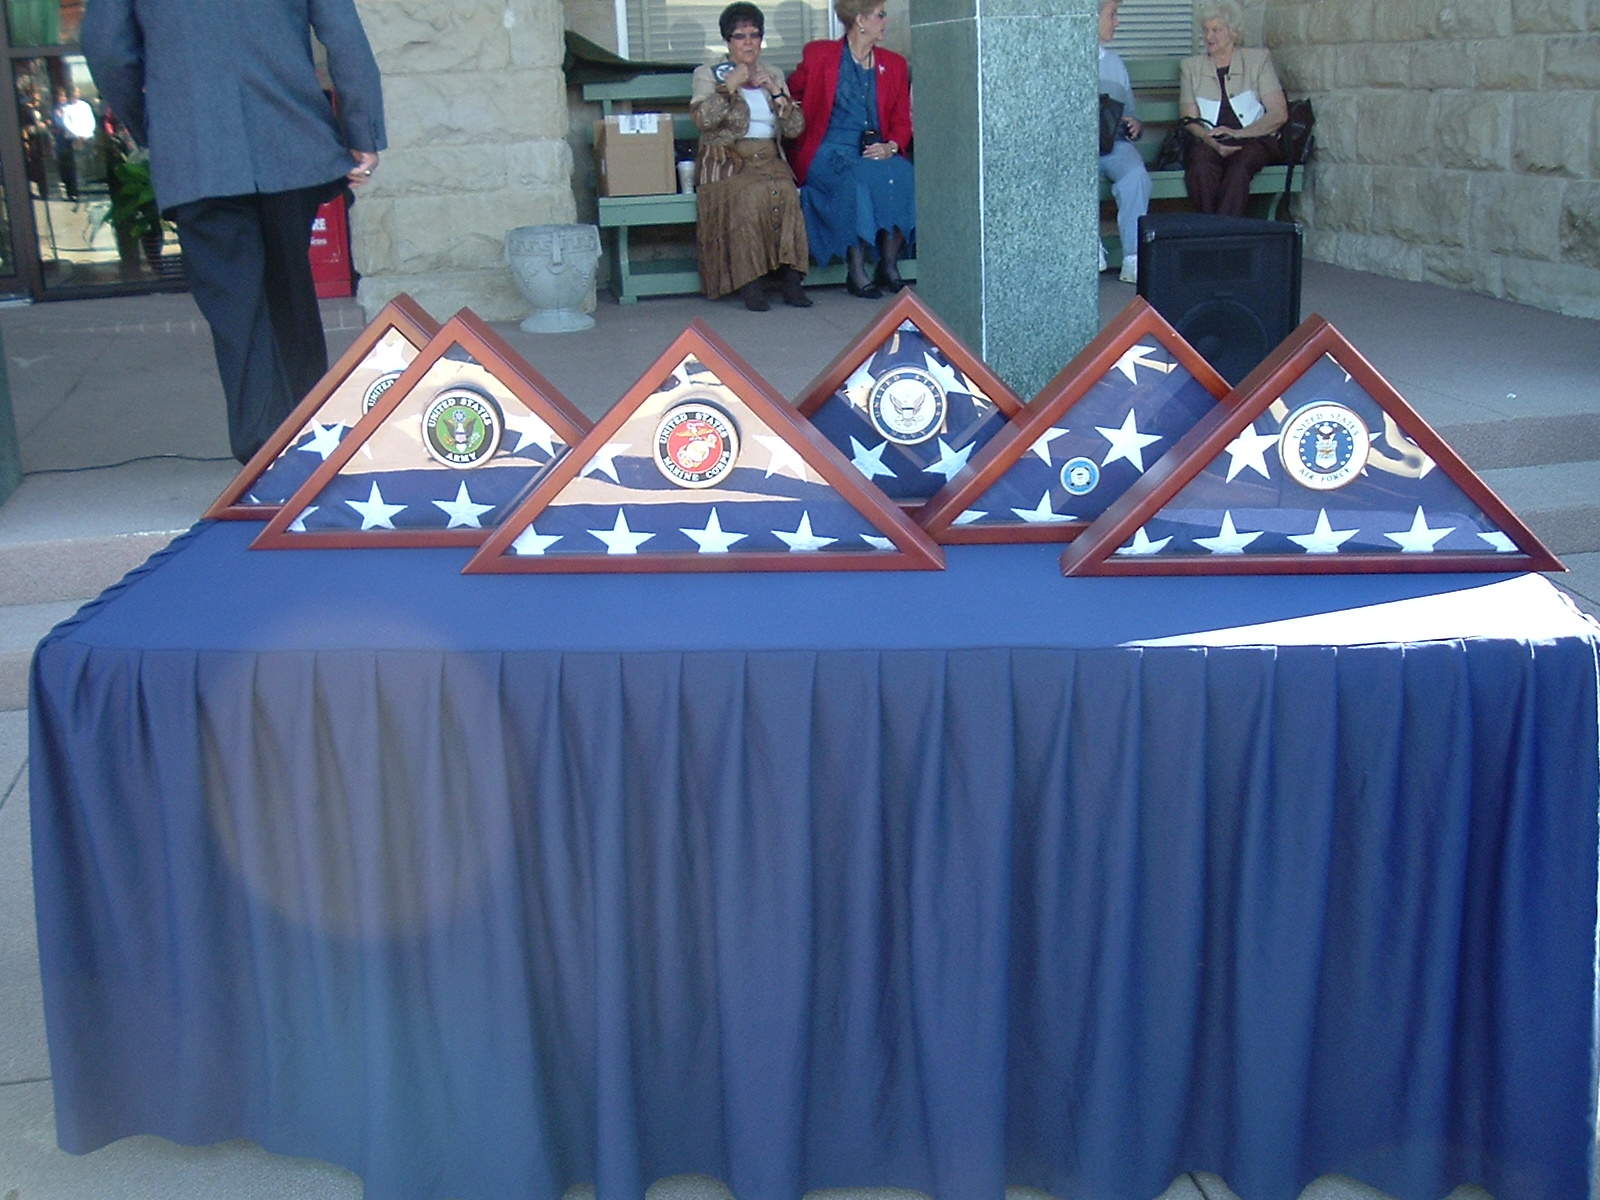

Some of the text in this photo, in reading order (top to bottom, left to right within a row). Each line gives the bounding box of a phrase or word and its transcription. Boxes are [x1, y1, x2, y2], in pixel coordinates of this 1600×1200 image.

[428, 397, 492, 428] UNITED STATES
[659, 412, 728, 444] UNITED STATES
[890, 428, 926, 440] NAVY
[1292, 413, 1360, 440] UNITED STATES
[444, 451, 477, 462] ARMY
[663, 450, 731, 481] MARINE CORPS
[1299, 467, 1352, 483] AIR FORCE
